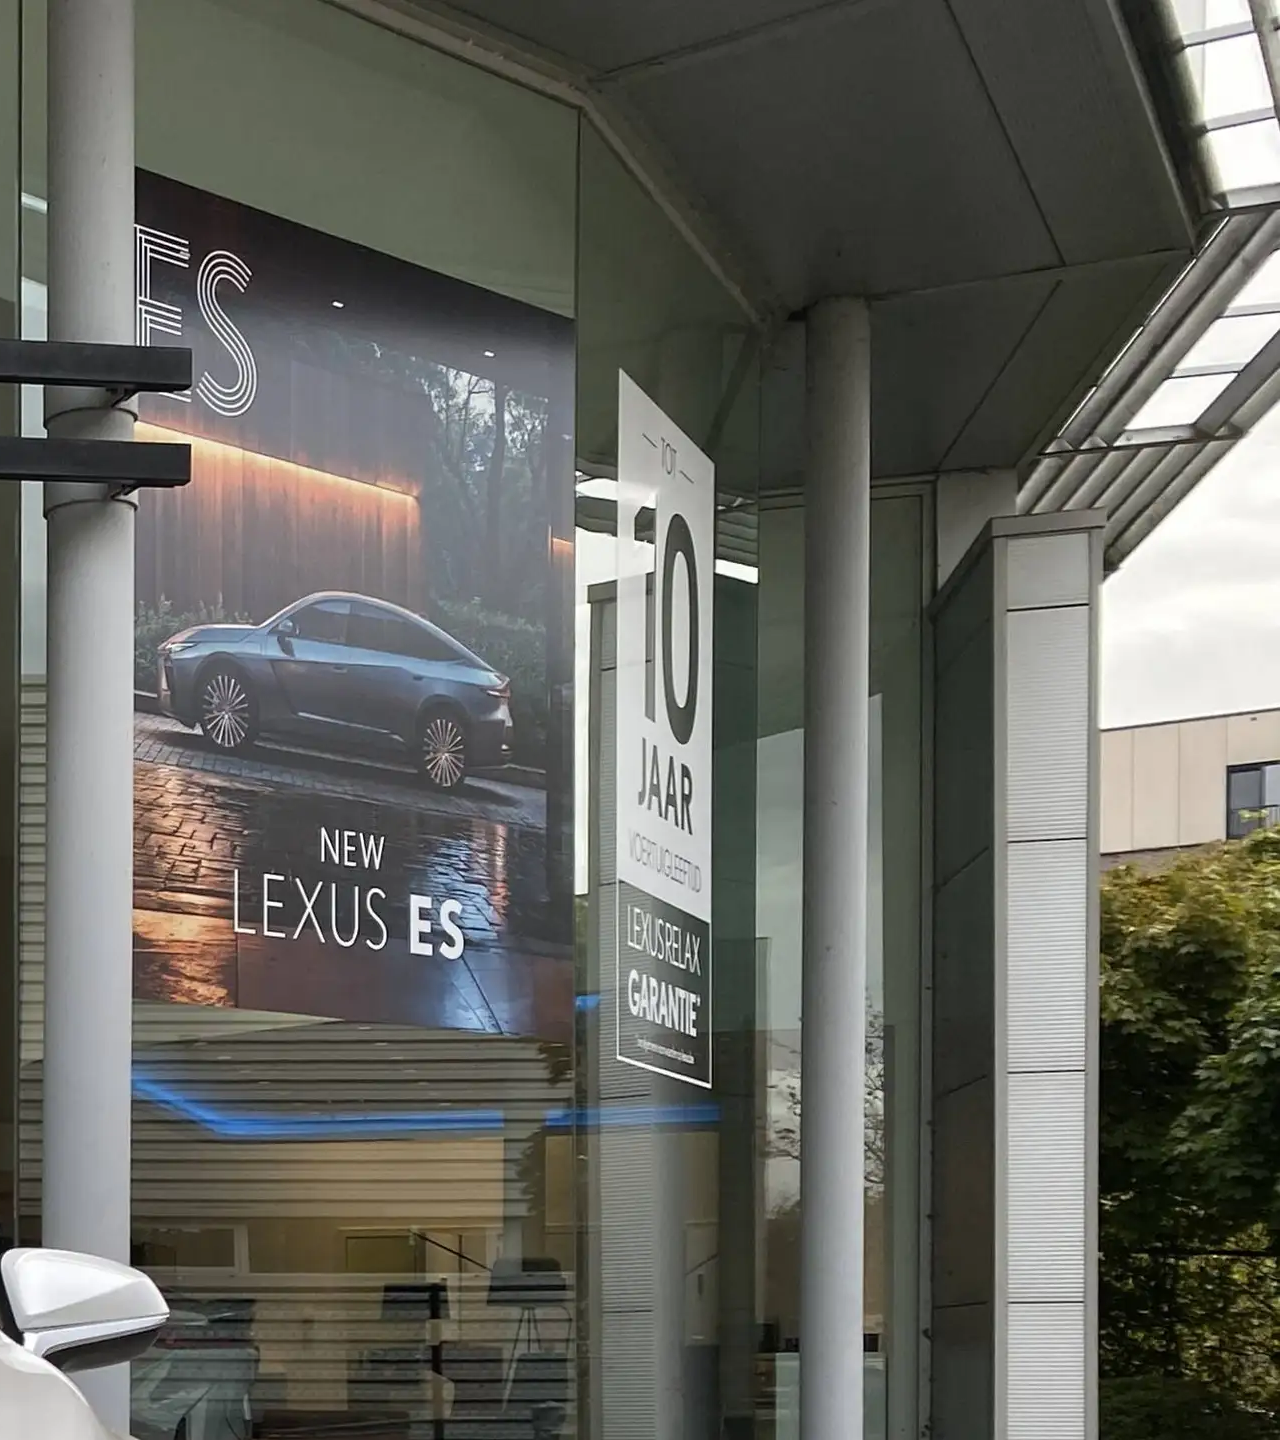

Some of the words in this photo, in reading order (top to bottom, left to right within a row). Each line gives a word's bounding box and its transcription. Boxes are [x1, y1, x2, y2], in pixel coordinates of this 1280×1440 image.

[134, 222, 258, 417] ES
[660, 436, 677, 479] TOT
[634, 490, 699, 745] 10
[638, 737, 693, 836] JAAR
[320, 826, 385, 870] NEW
[234, 868, 388, 950] LEXUS
[409, 893, 464, 960] ES
[627, 904, 665, 960] LEXUS
[665, 921, 701, 976] RELAX
